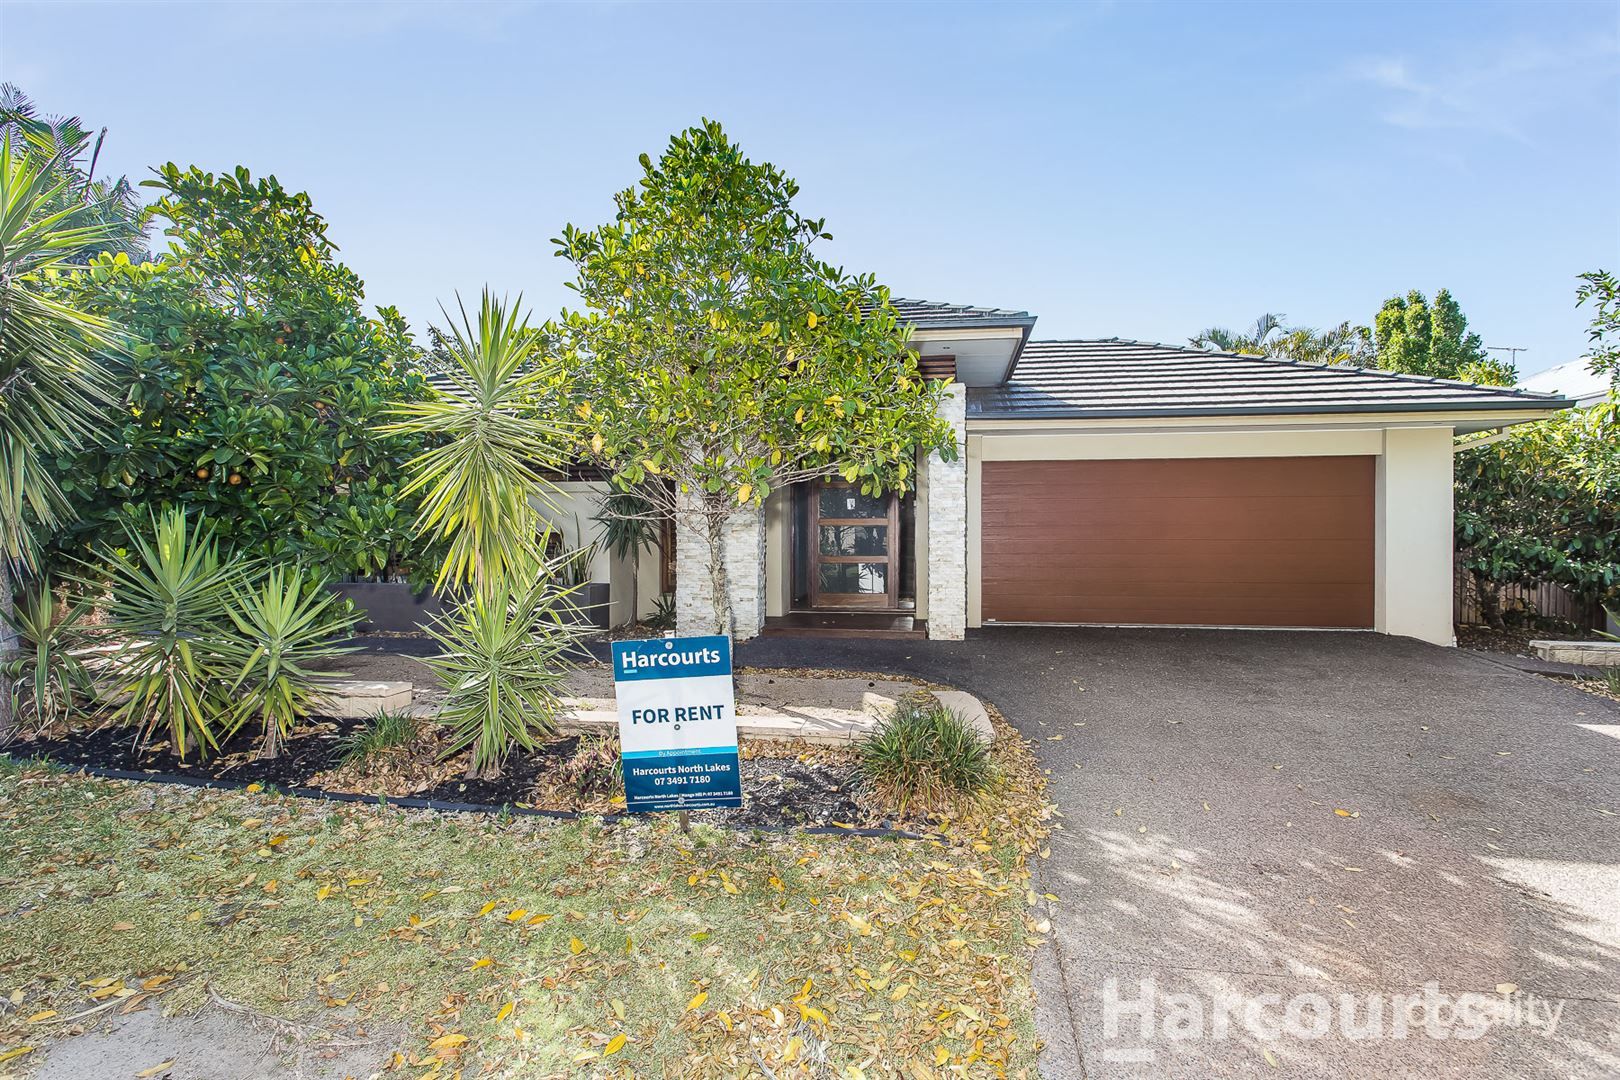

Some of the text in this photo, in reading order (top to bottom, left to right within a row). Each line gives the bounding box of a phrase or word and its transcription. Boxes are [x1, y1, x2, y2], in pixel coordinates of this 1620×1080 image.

[621, 647, 721, 669] Harcourts
[632, 704, 725, 725] FOR RENT
[632, 763, 731, 776] Harcourts North Lakes
[654, 775, 711, 786] 07 3491 7180
